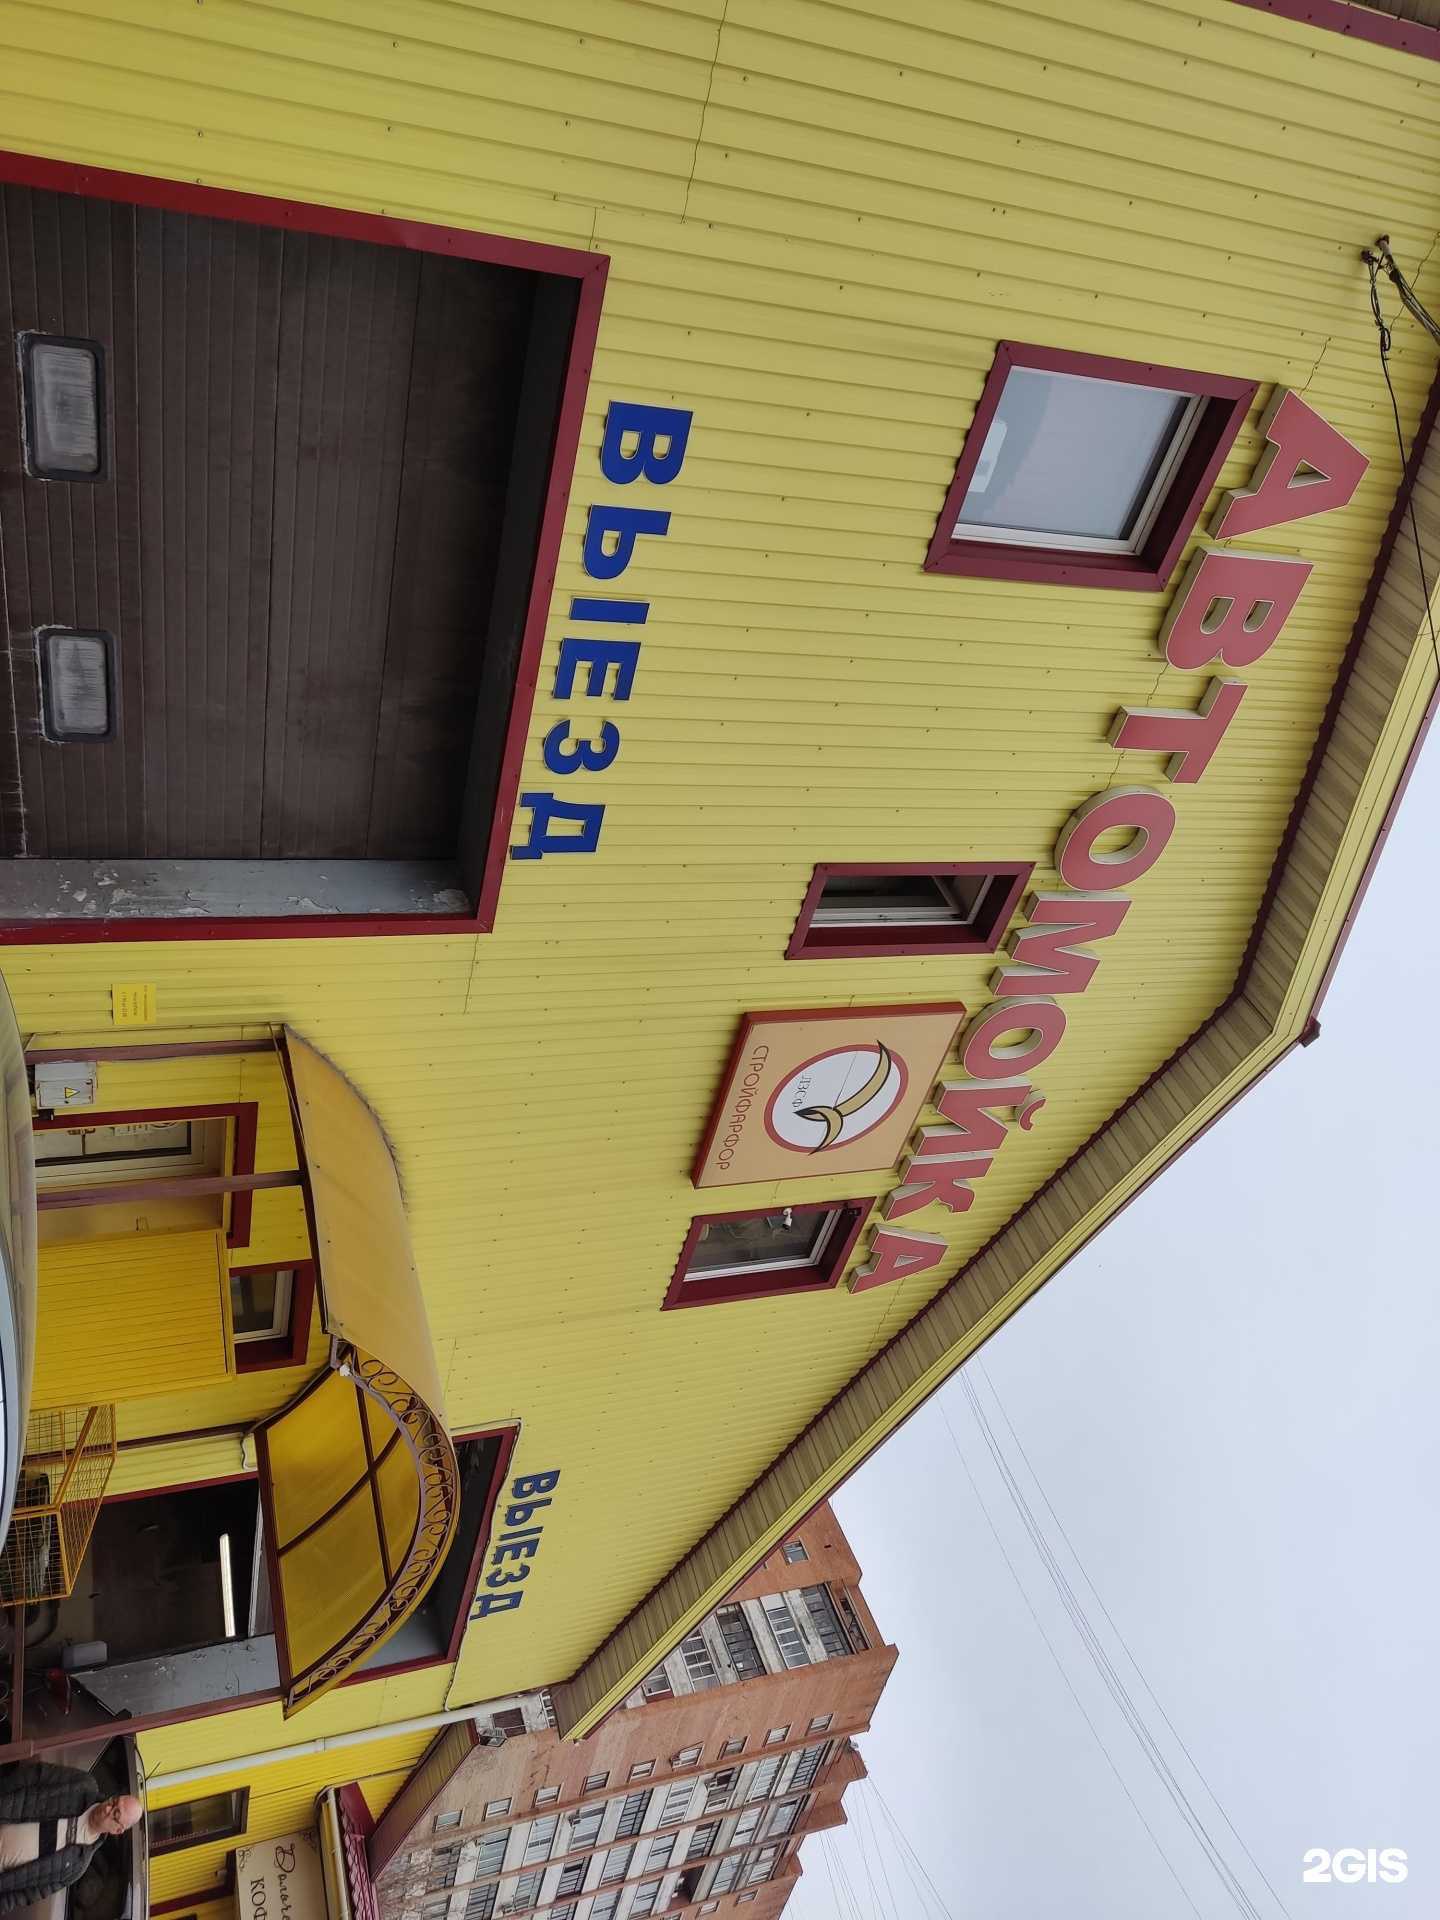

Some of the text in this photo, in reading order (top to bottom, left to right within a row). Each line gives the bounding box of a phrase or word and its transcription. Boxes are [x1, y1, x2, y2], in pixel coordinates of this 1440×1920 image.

[509, 400, 694, 861] ВЫЕЗД
[849, 384, 1371, 1295] АВТОМОЙКА
[714, 1045, 769, 1171] СТРОЙФАРФОР
[469, 1469, 561, 1621] ВЫЕЗД
